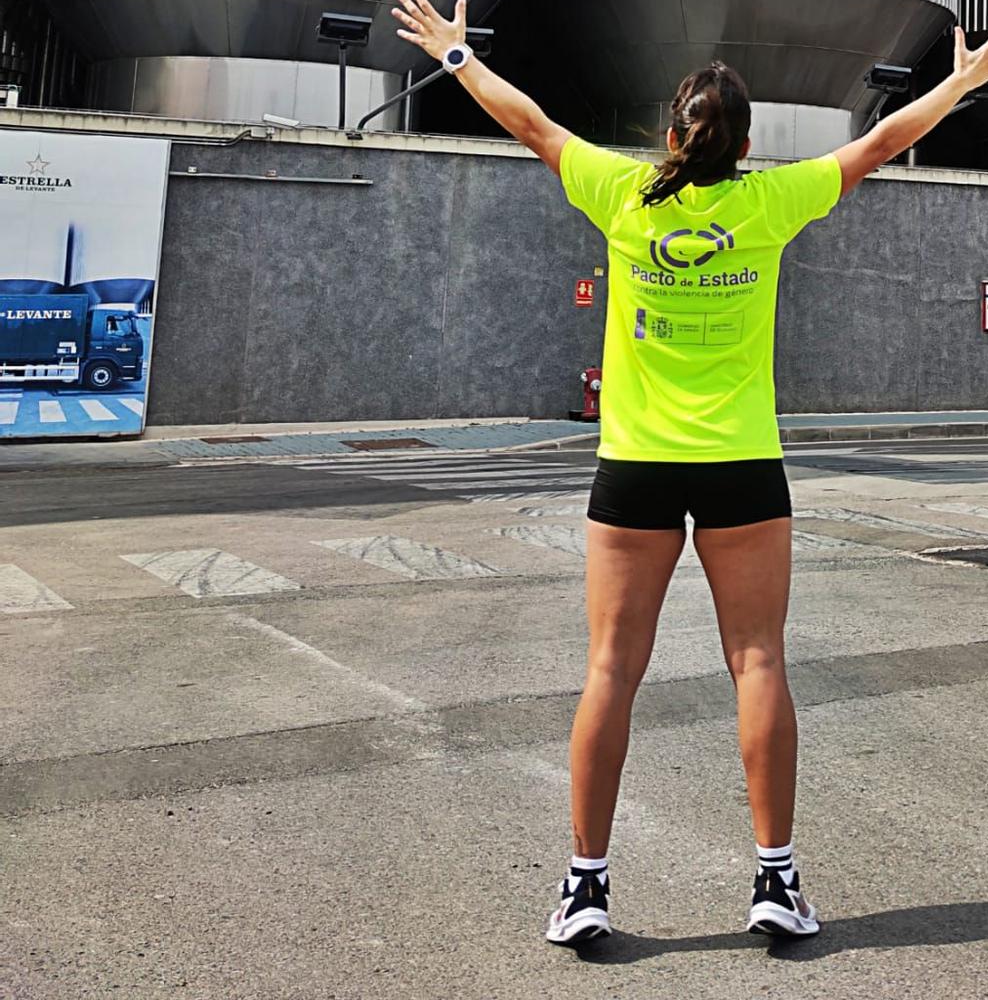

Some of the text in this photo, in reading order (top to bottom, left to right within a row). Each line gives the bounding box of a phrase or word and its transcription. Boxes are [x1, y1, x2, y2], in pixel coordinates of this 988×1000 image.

[0, 176, 72, 187] ESTRELLA
[631, 264, 758, 287] Pacto de Estado
[659, 287, 668, 297] la
[669, 288, 710, 298] violencia
[711, 288, 722, 298] de
[723, 286, 755, 299] género
[7, 310, 72, 319] LEVANTE
